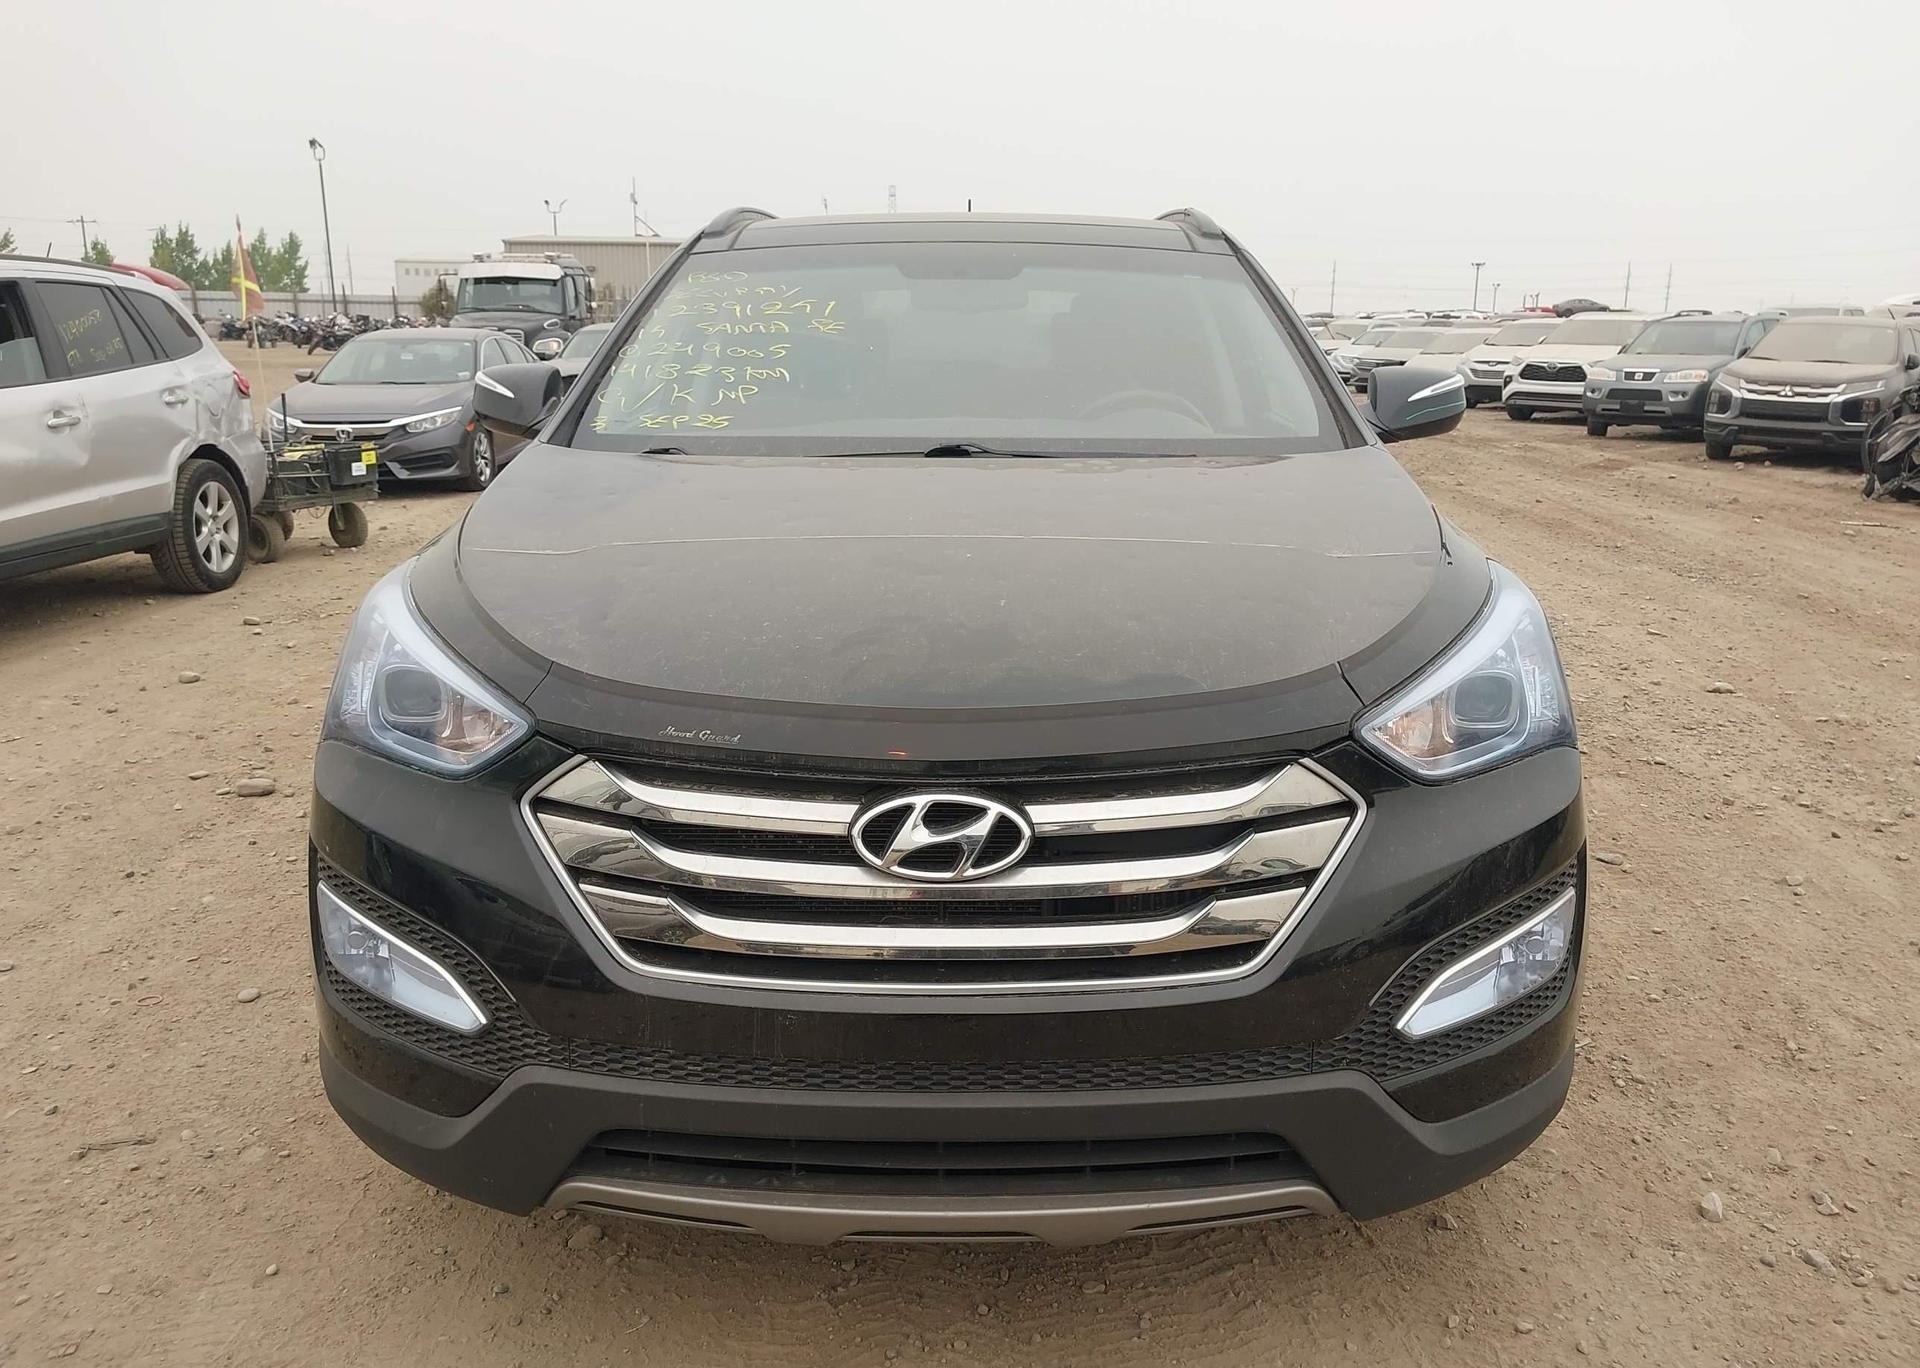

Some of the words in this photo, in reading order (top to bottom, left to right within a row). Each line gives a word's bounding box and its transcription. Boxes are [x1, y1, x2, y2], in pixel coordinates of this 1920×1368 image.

[696, 321, 790, 336] SANTA
[658, 725, 697, 739] Hood
[699, 730, 742, 742] Guard
